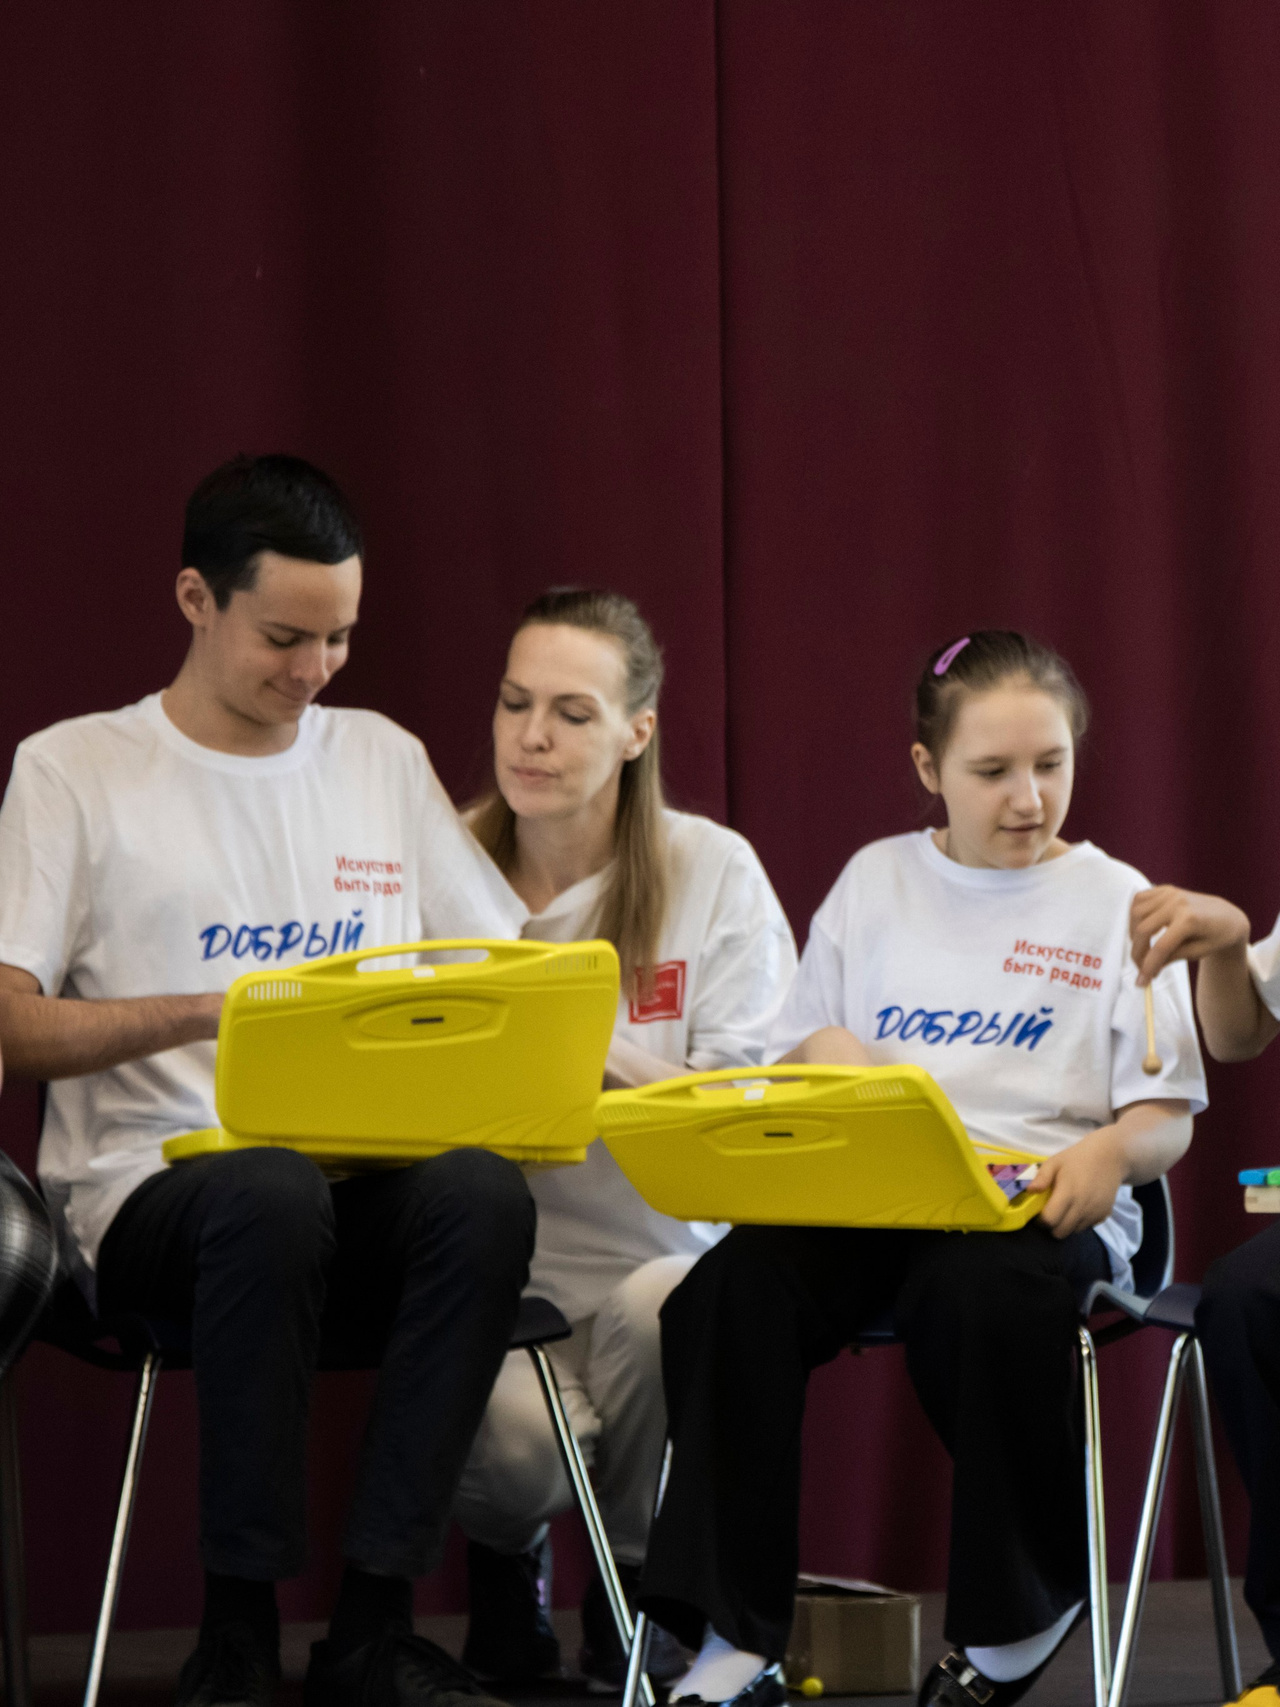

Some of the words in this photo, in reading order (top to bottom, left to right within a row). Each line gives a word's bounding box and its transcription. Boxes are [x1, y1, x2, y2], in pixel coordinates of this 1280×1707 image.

[333, 877, 370, 892] быть
[199, 909, 365, 961] ДОБРЫЙ
[1013, 940, 1103, 969] Искусство
[1003, 958, 1044, 975] быть
[1049, 967, 1103, 991] рядом
[874, 1005, 1053, 1050] ДОБРЫЙ
